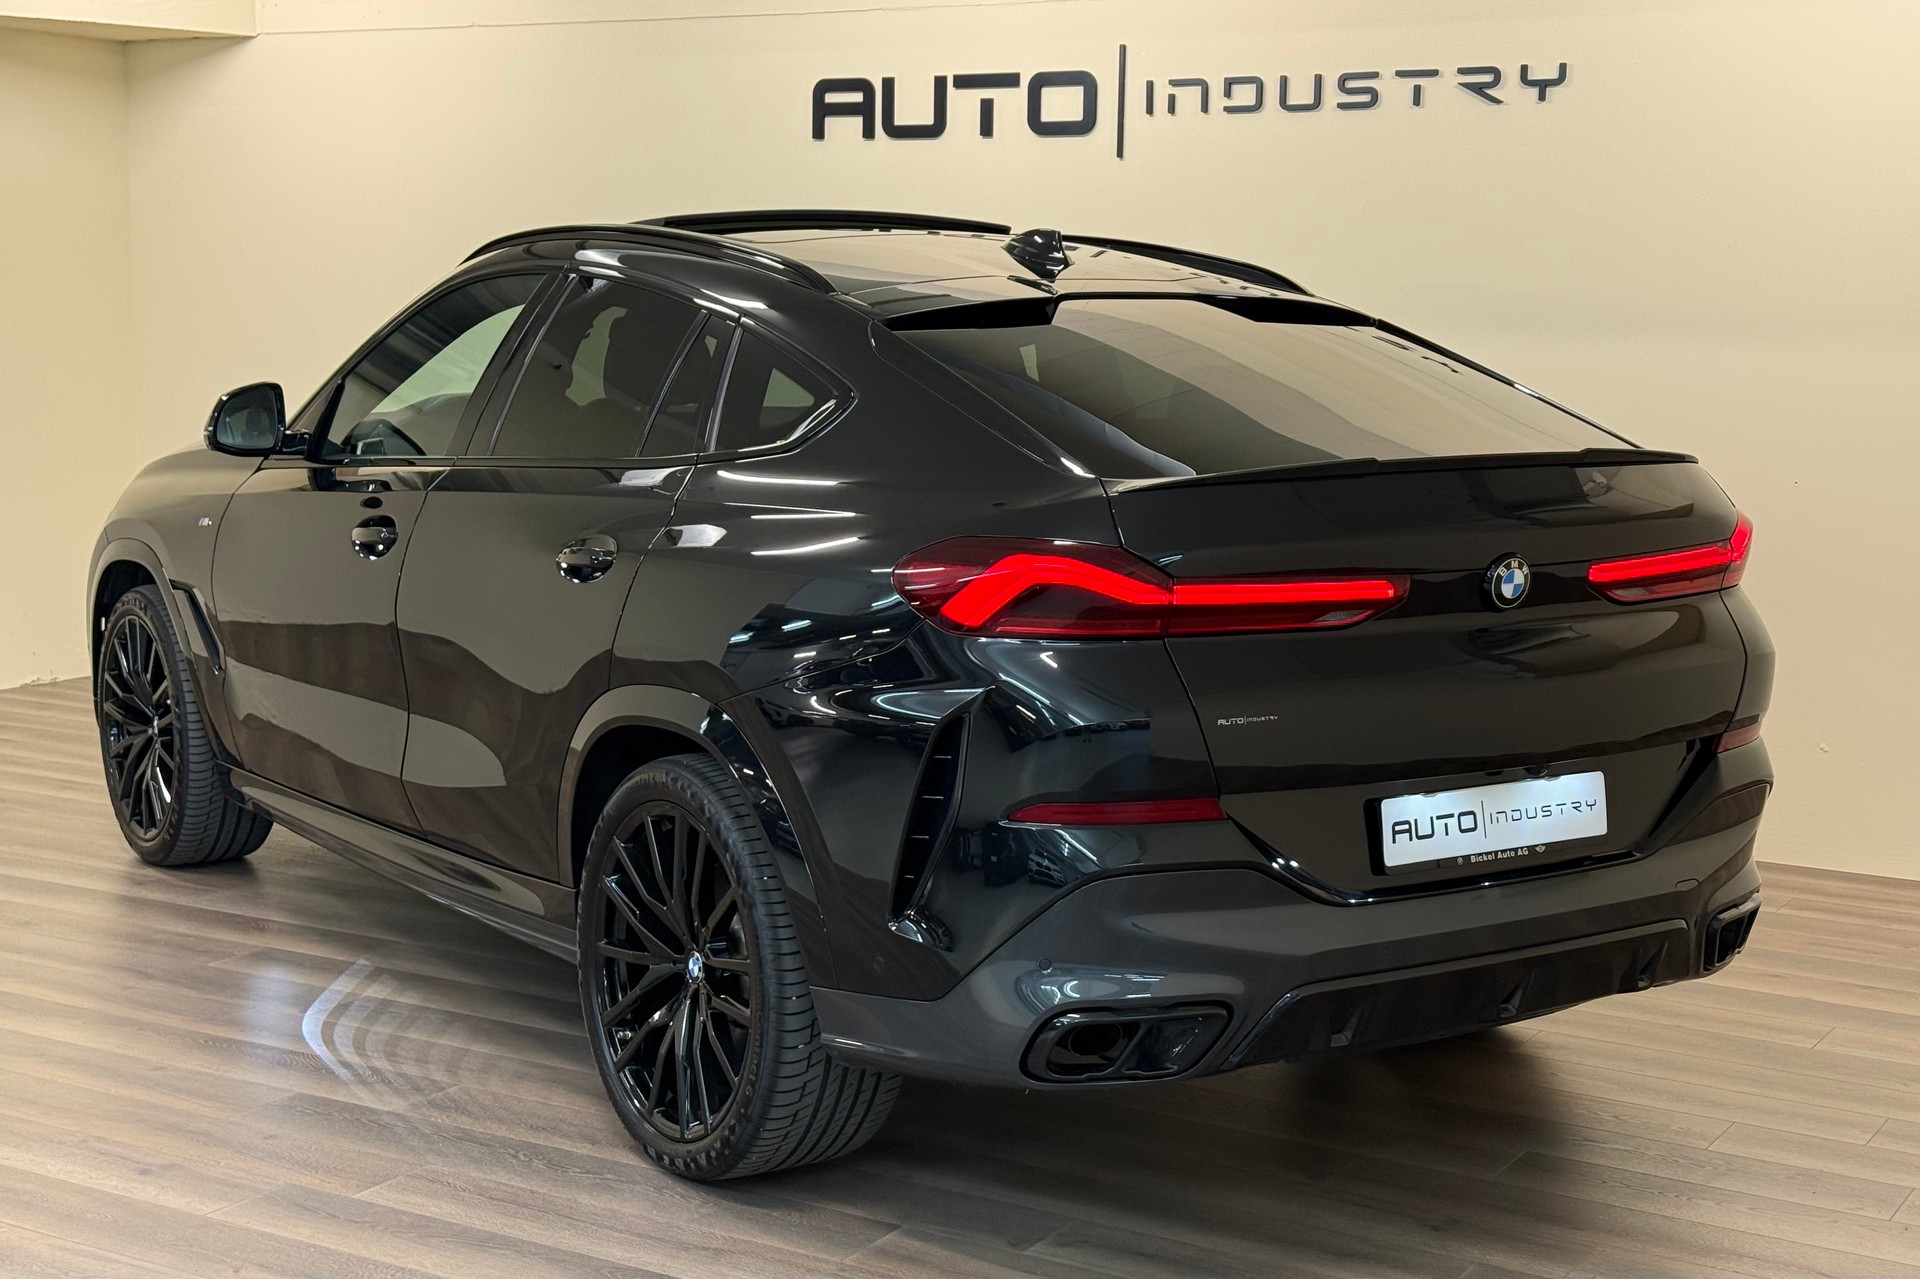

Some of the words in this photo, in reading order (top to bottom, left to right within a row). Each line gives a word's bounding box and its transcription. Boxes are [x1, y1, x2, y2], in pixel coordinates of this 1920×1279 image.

[812, 70, 1098, 140] AUTO
[1498, 560, 1529, 577] BMW
[1217, 717, 1244, 726] AUTO
[1391, 810, 1478, 844] AUTO
[1470, 852, 1495, 863] Bickel
[1497, 851, 1516, 859] Auto
[1517, 847, 1529, 856] AG
